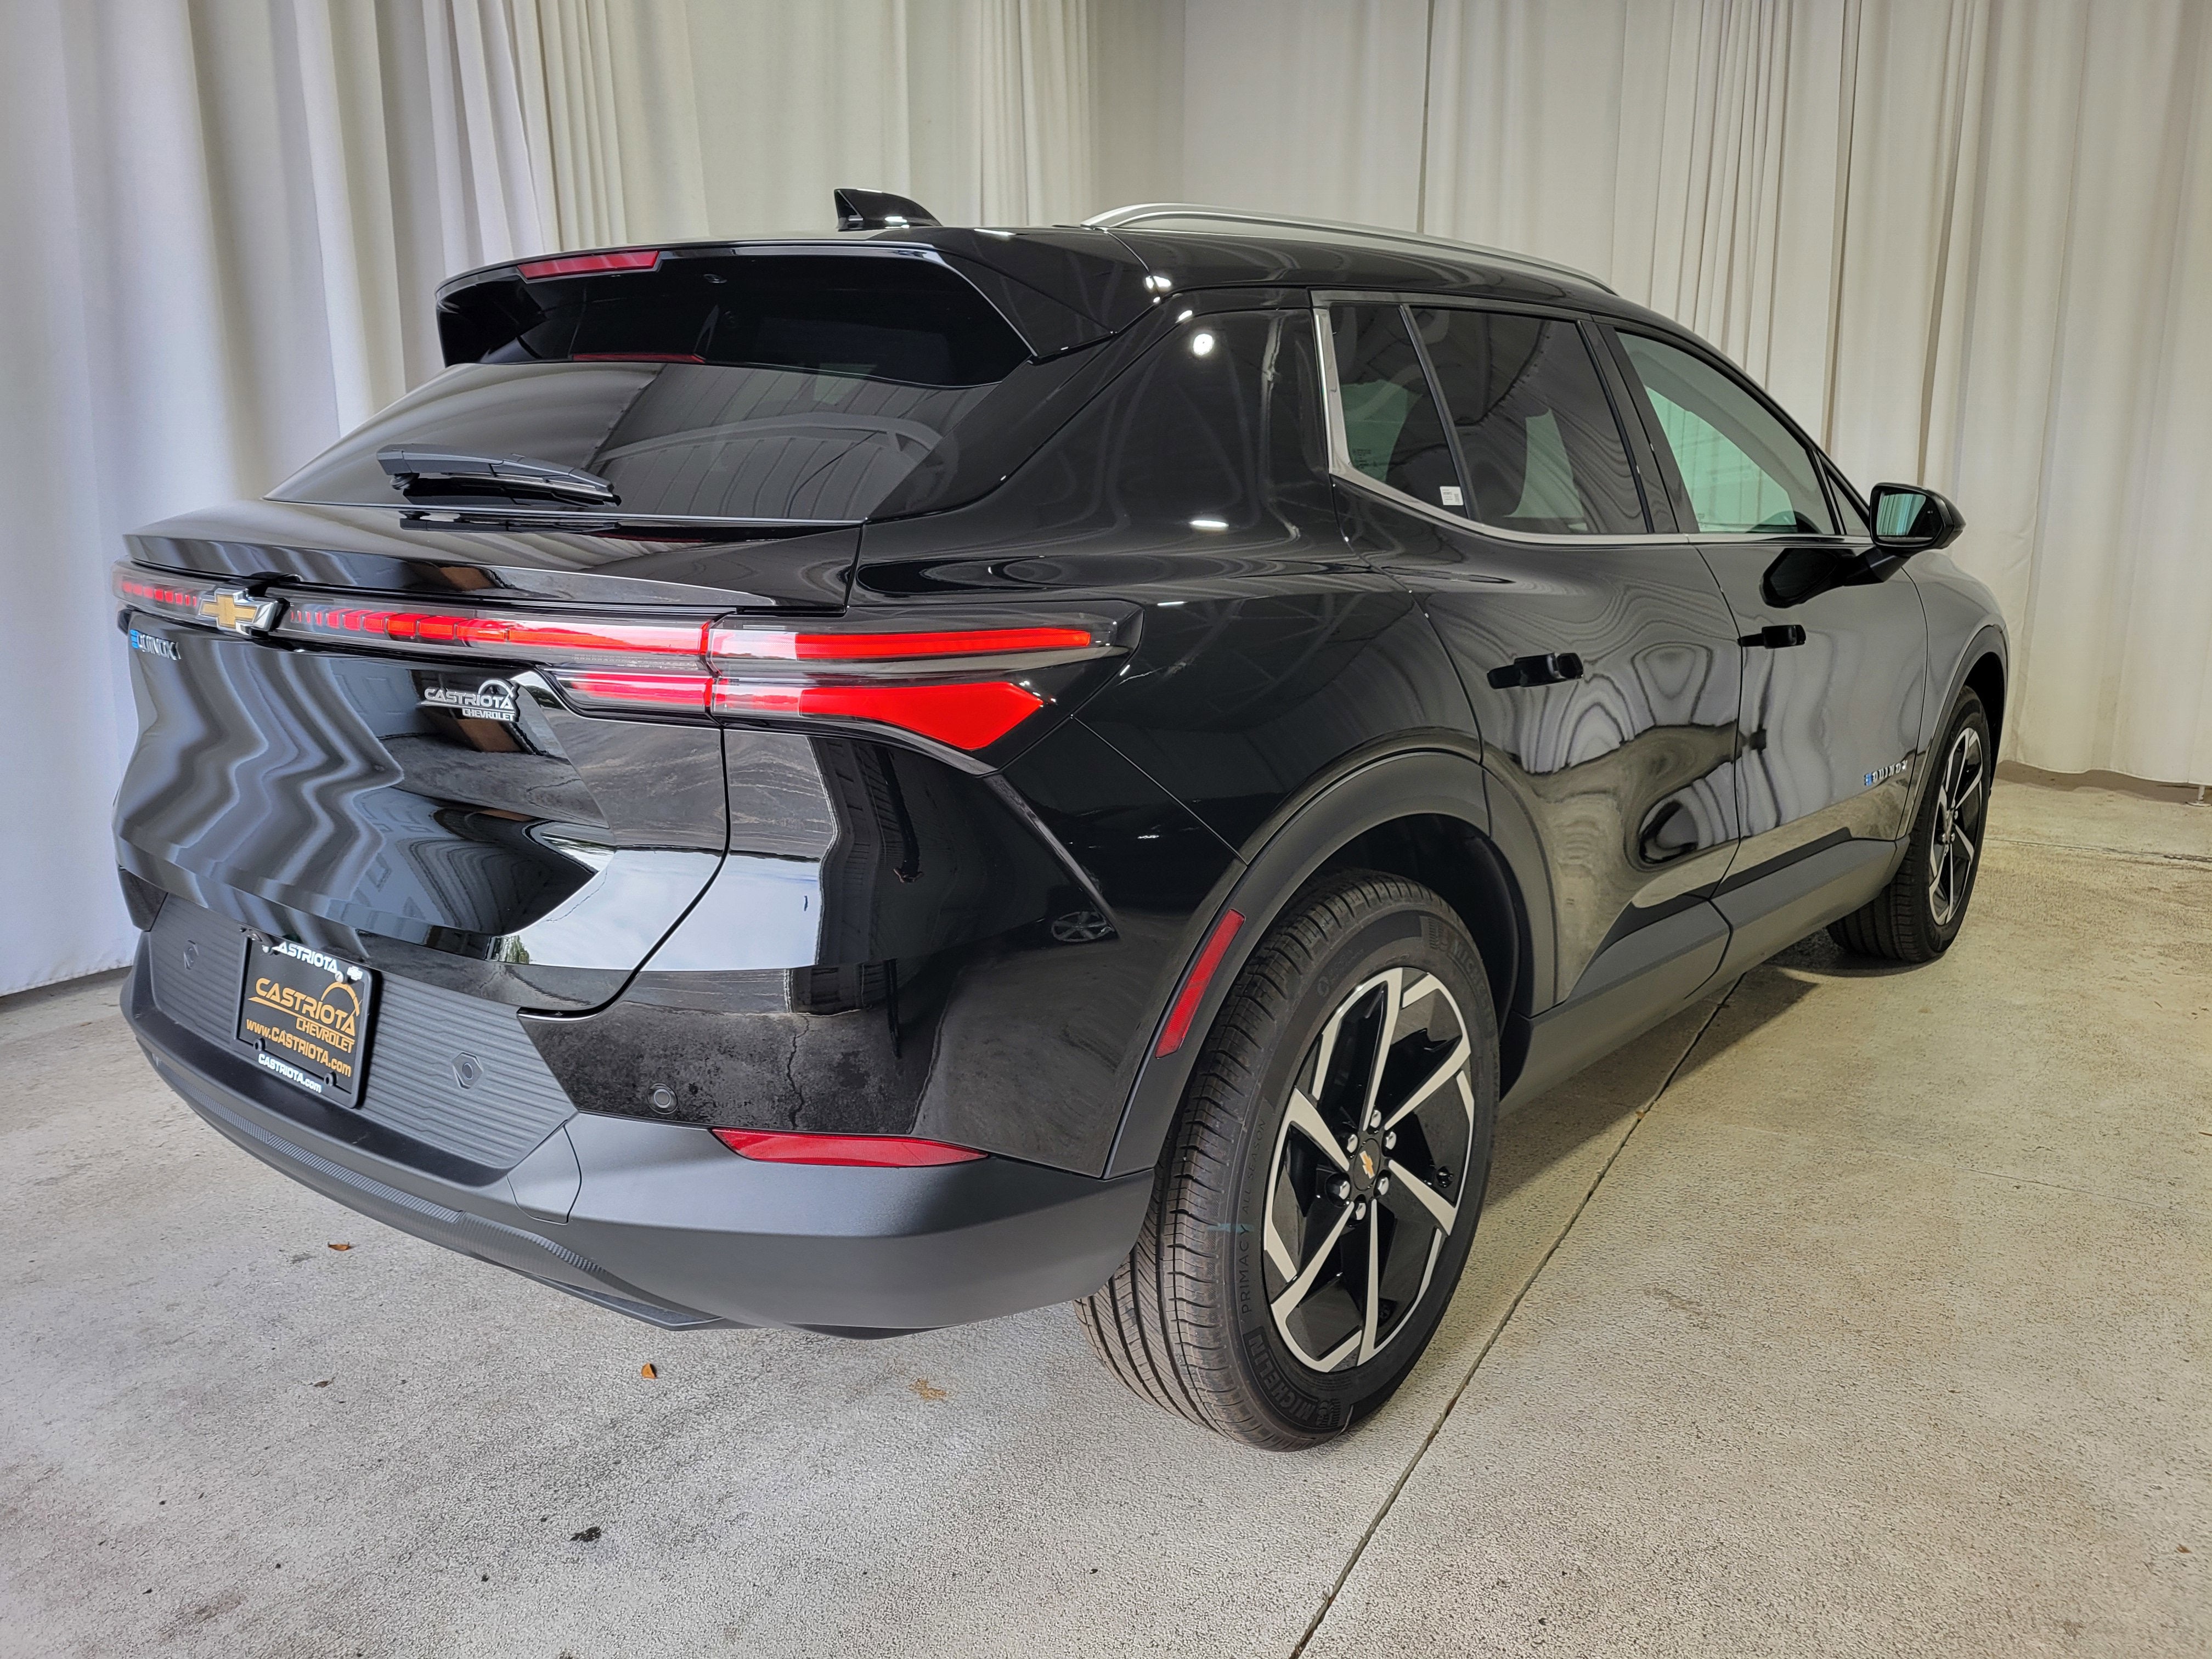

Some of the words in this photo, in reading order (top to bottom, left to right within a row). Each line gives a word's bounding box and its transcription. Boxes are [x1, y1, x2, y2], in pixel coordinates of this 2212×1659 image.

[424, 685, 514, 709] CASTRIOTA
[462, 708, 515, 721] CHEVROLET
[267, 941, 338, 973] ASTRIOTA
[255, 978, 356, 1036] CASTRIOTA
[246, 1019, 351, 1077] www.CASTRIOTA.com
[296, 1018, 356, 1053] CHEVROLET
[258, 1053, 322, 1093] CASTRIOTA.com
[1248, 1119, 1266, 1180] SEASON
[1242, 1189, 1251, 1215] ALL
[1239, 1224, 1252, 1314] PRIMACY
[1249, 1334, 1317, 1421] MICHELIN
